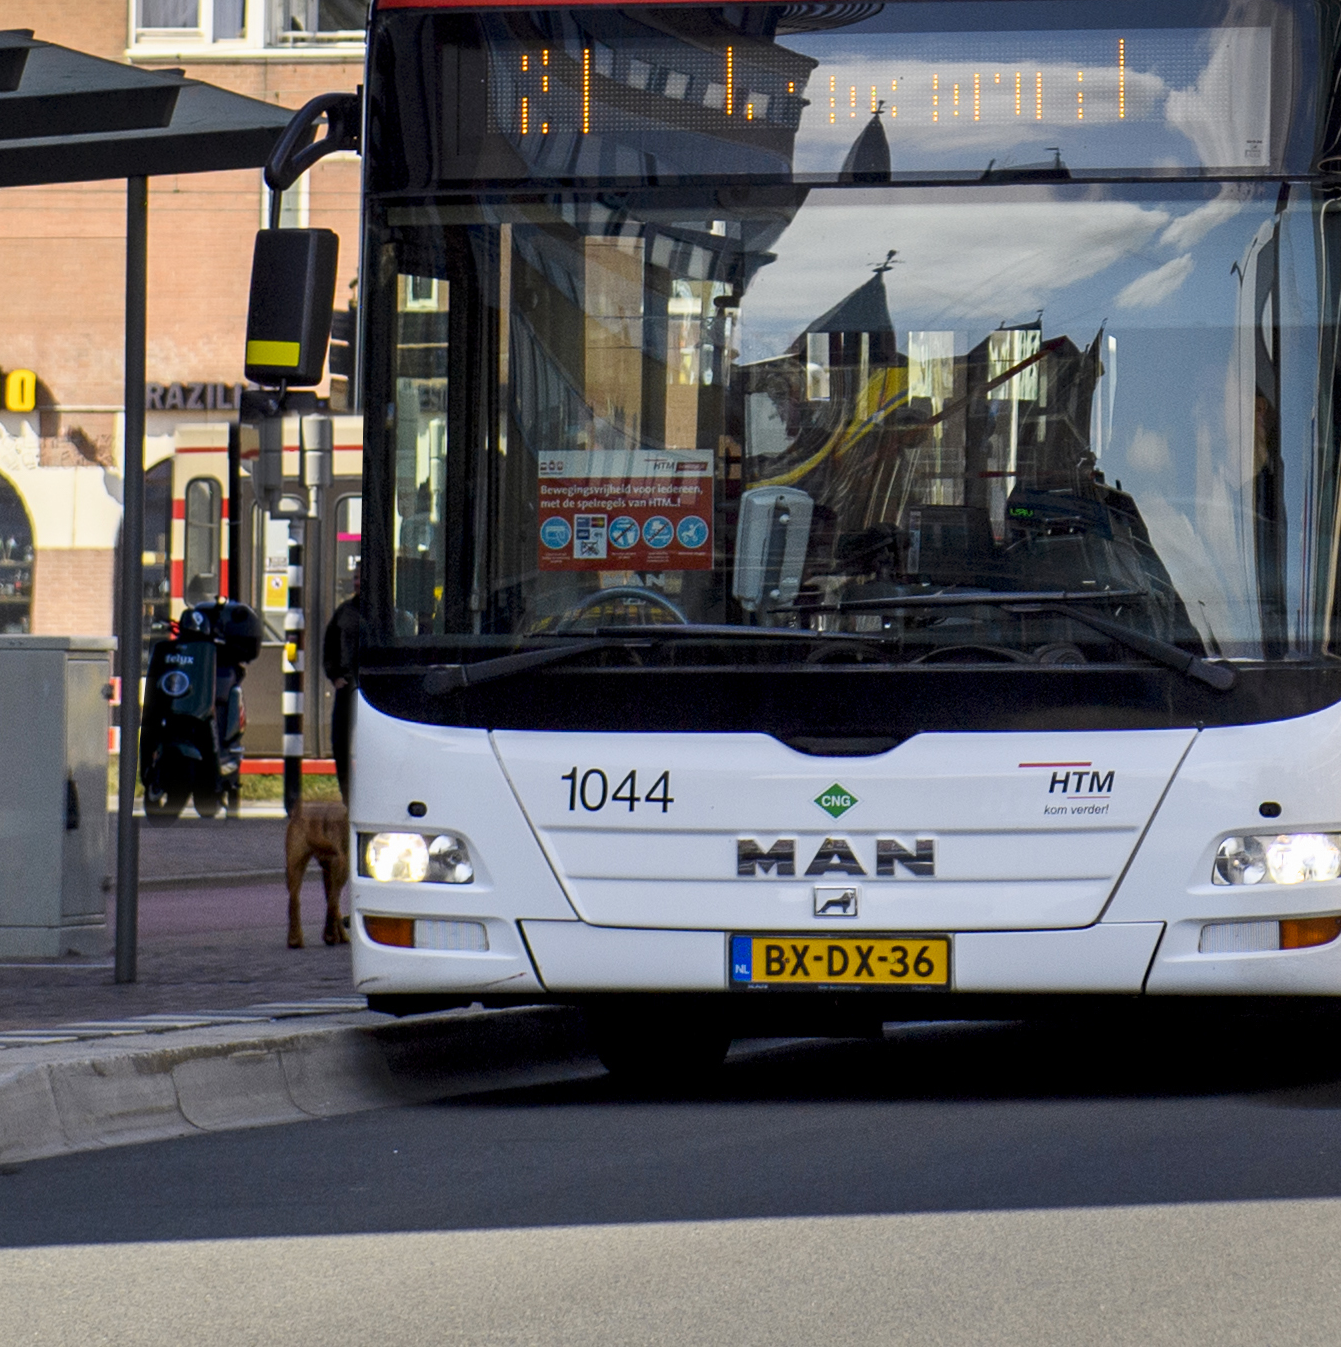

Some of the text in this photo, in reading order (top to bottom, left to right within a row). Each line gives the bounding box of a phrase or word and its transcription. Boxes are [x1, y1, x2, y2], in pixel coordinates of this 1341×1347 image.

[146, 382, 242, 410] RAZILI
[540, 484, 632, 497] Bewegingsvrijheid
[633, 486, 656, 495] voor
[540, 499, 559, 508] met
[562, 498, 575, 508] de
[577, 498, 626, 510] spelregels
[628, 499, 647, 507] van
[561, 766, 675, 813] 1044
[1048, 770, 1116, 794] HTM
[820, 794, 852, 808] CNG
[1044, 803, 1110, 815] kom verder!
[736, 837, 937, 877] MAN
[735, 963, 750, 975] NL
[764, 943, 935, 978] BX-DX-36
